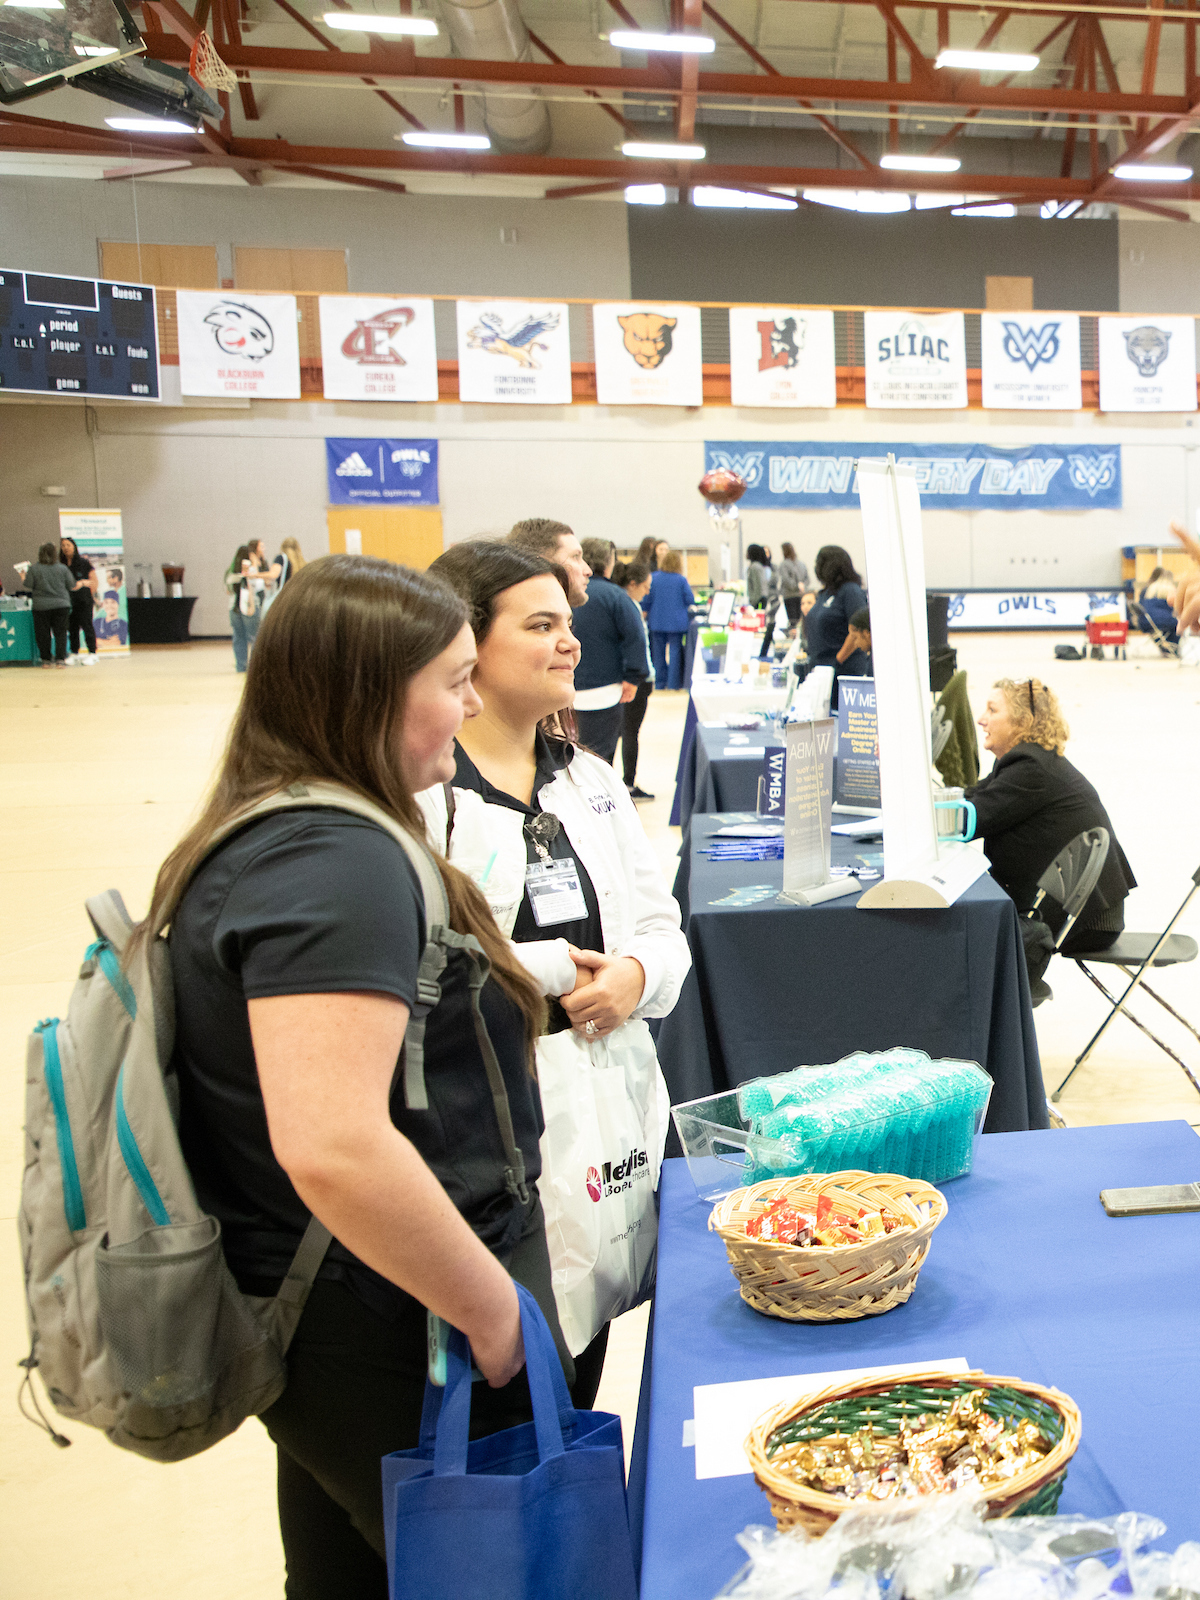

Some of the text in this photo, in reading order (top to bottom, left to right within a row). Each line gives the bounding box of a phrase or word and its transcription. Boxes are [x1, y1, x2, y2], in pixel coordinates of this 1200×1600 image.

[112, 285, 142, 301] Guests
[50, 320, 79, 333] period
[50, 339, 81, 353] player
[127, 345, 149, 359] fouls
[878, 333, 949, 363] SLIAC
[56, 378, 149, 394] game won
[769, 457, 854, 494] WIN
[979, 458, 1064, 495] DAY
[998, 595, 1057, 614] OWLS
[842, 686, 858, 706] W
[768, 752, 785, 811] W MBA
